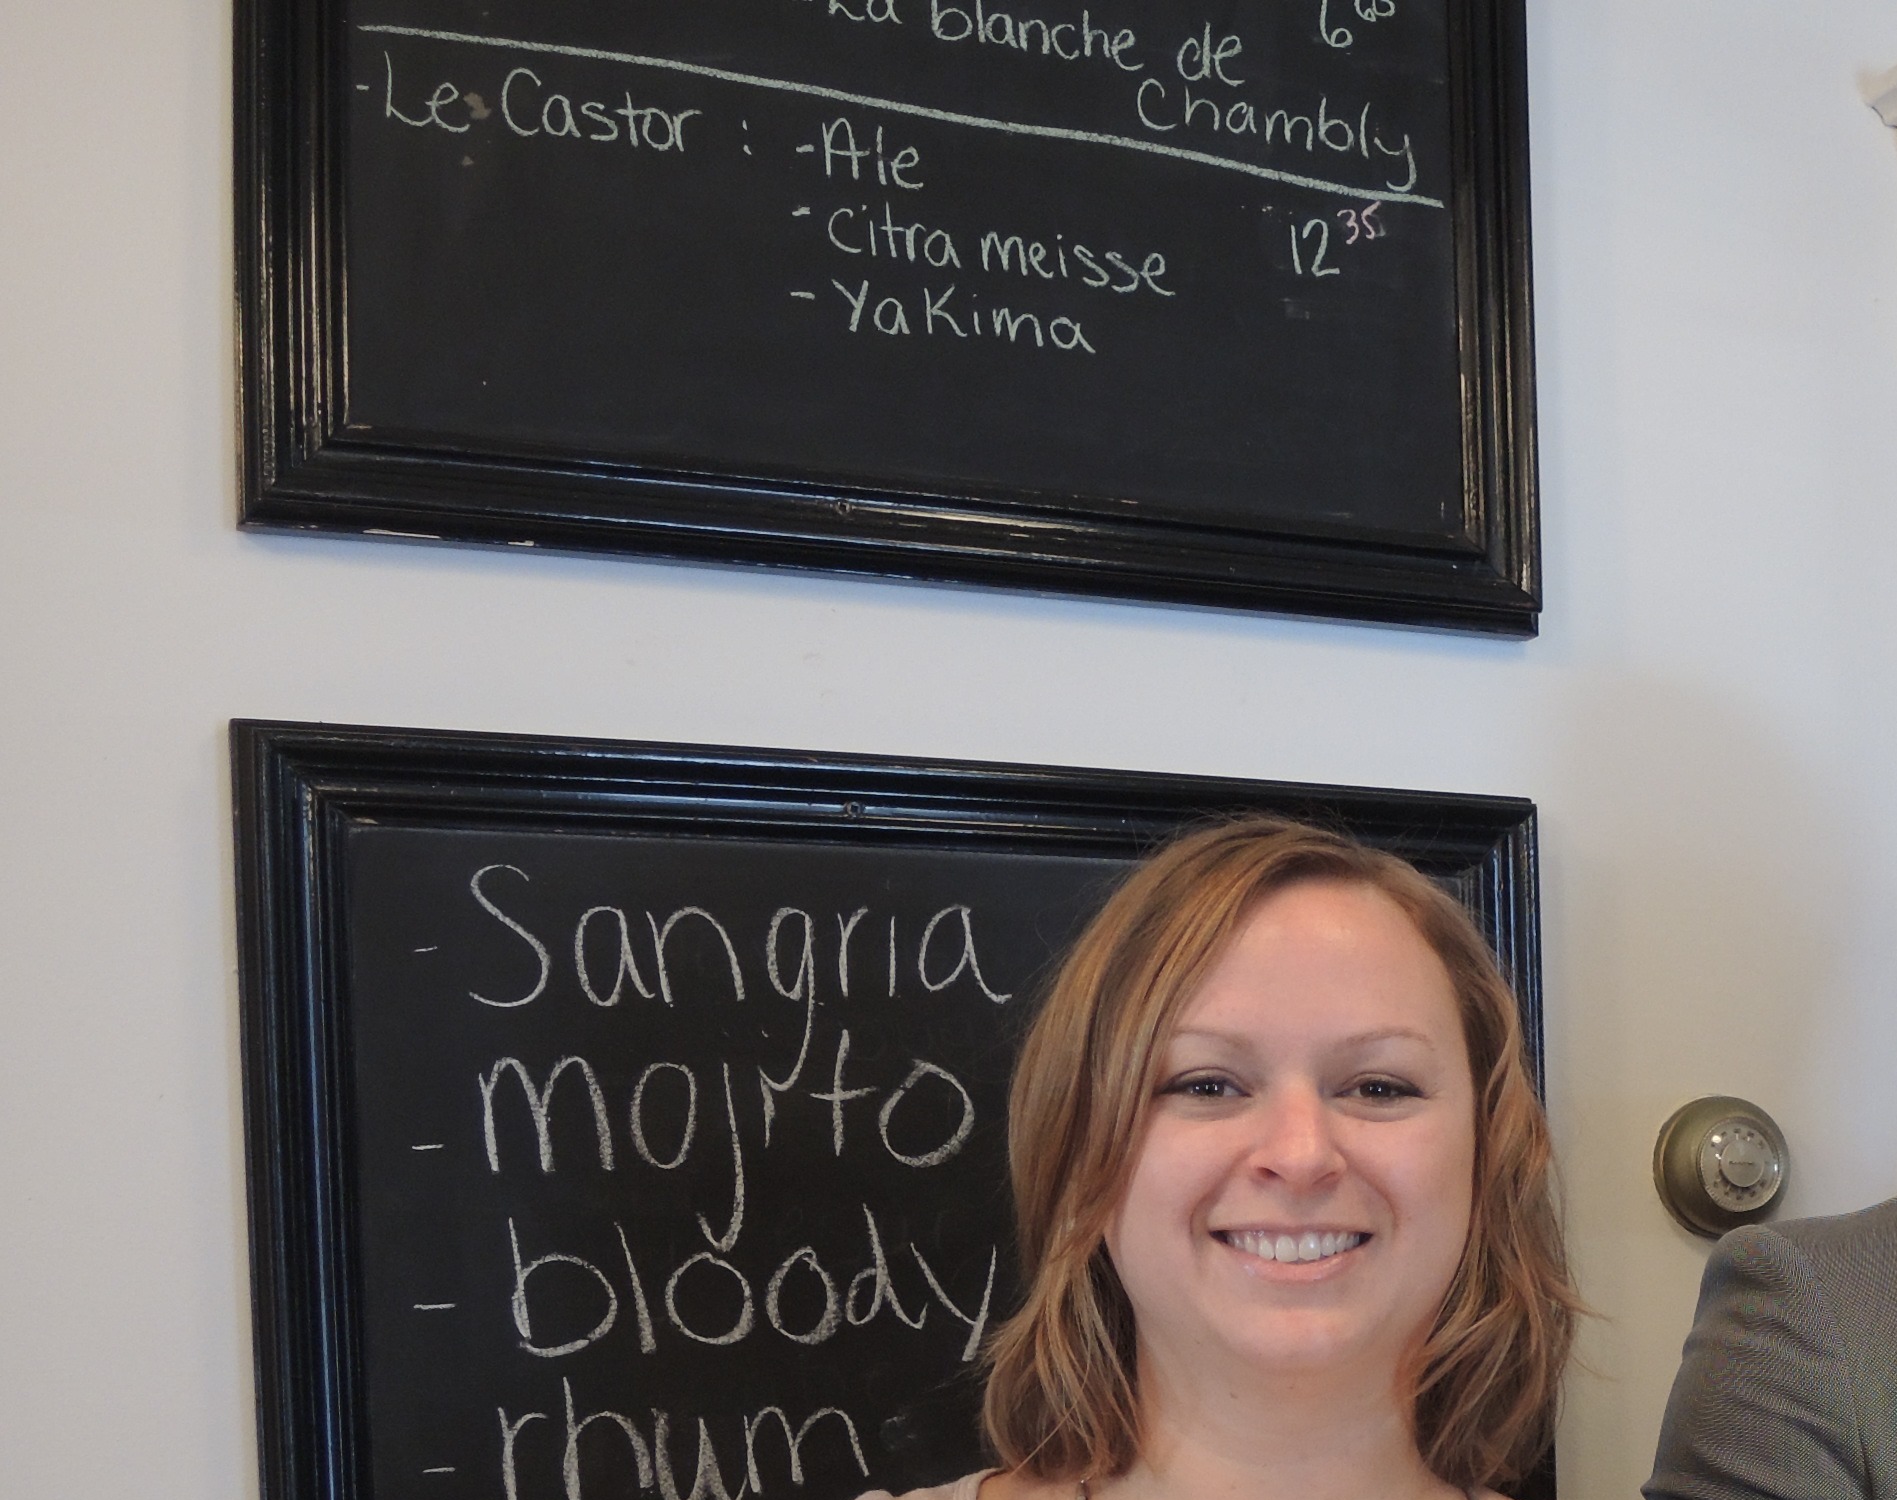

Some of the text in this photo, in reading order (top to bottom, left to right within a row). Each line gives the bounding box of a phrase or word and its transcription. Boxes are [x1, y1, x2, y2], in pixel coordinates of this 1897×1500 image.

[501, 67, 703, 153] Castor
[931, 0, 1143, 72] blanche
[1177, 23, 1244, 86] de
[1137, 78, 1417, 191] Chambly
[469, 864, 1012, 1092] Sangria
[478, 1029, 975, 1252] mojito
[510, 1203, 997, 1362] bloody
